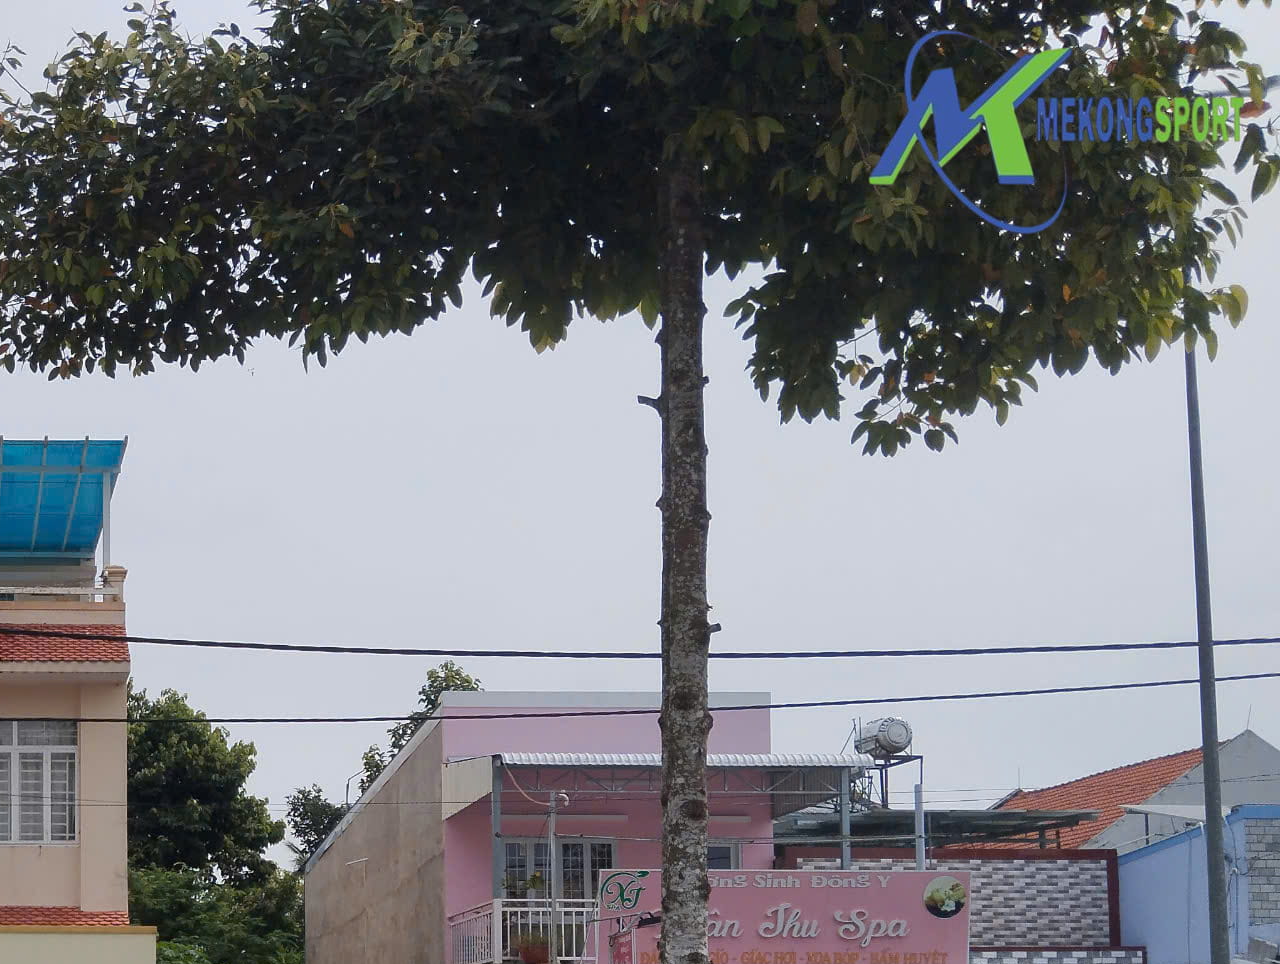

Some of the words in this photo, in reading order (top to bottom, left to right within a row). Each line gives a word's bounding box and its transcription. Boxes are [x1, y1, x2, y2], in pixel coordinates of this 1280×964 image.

[752, 873, 801, 888] Sinh
[810, 874, 872, 888] Đông
[877, 875, 892, 888] Y
[758, 902, 821, 938] Thu
[833, 909, 911, 948] Spa
